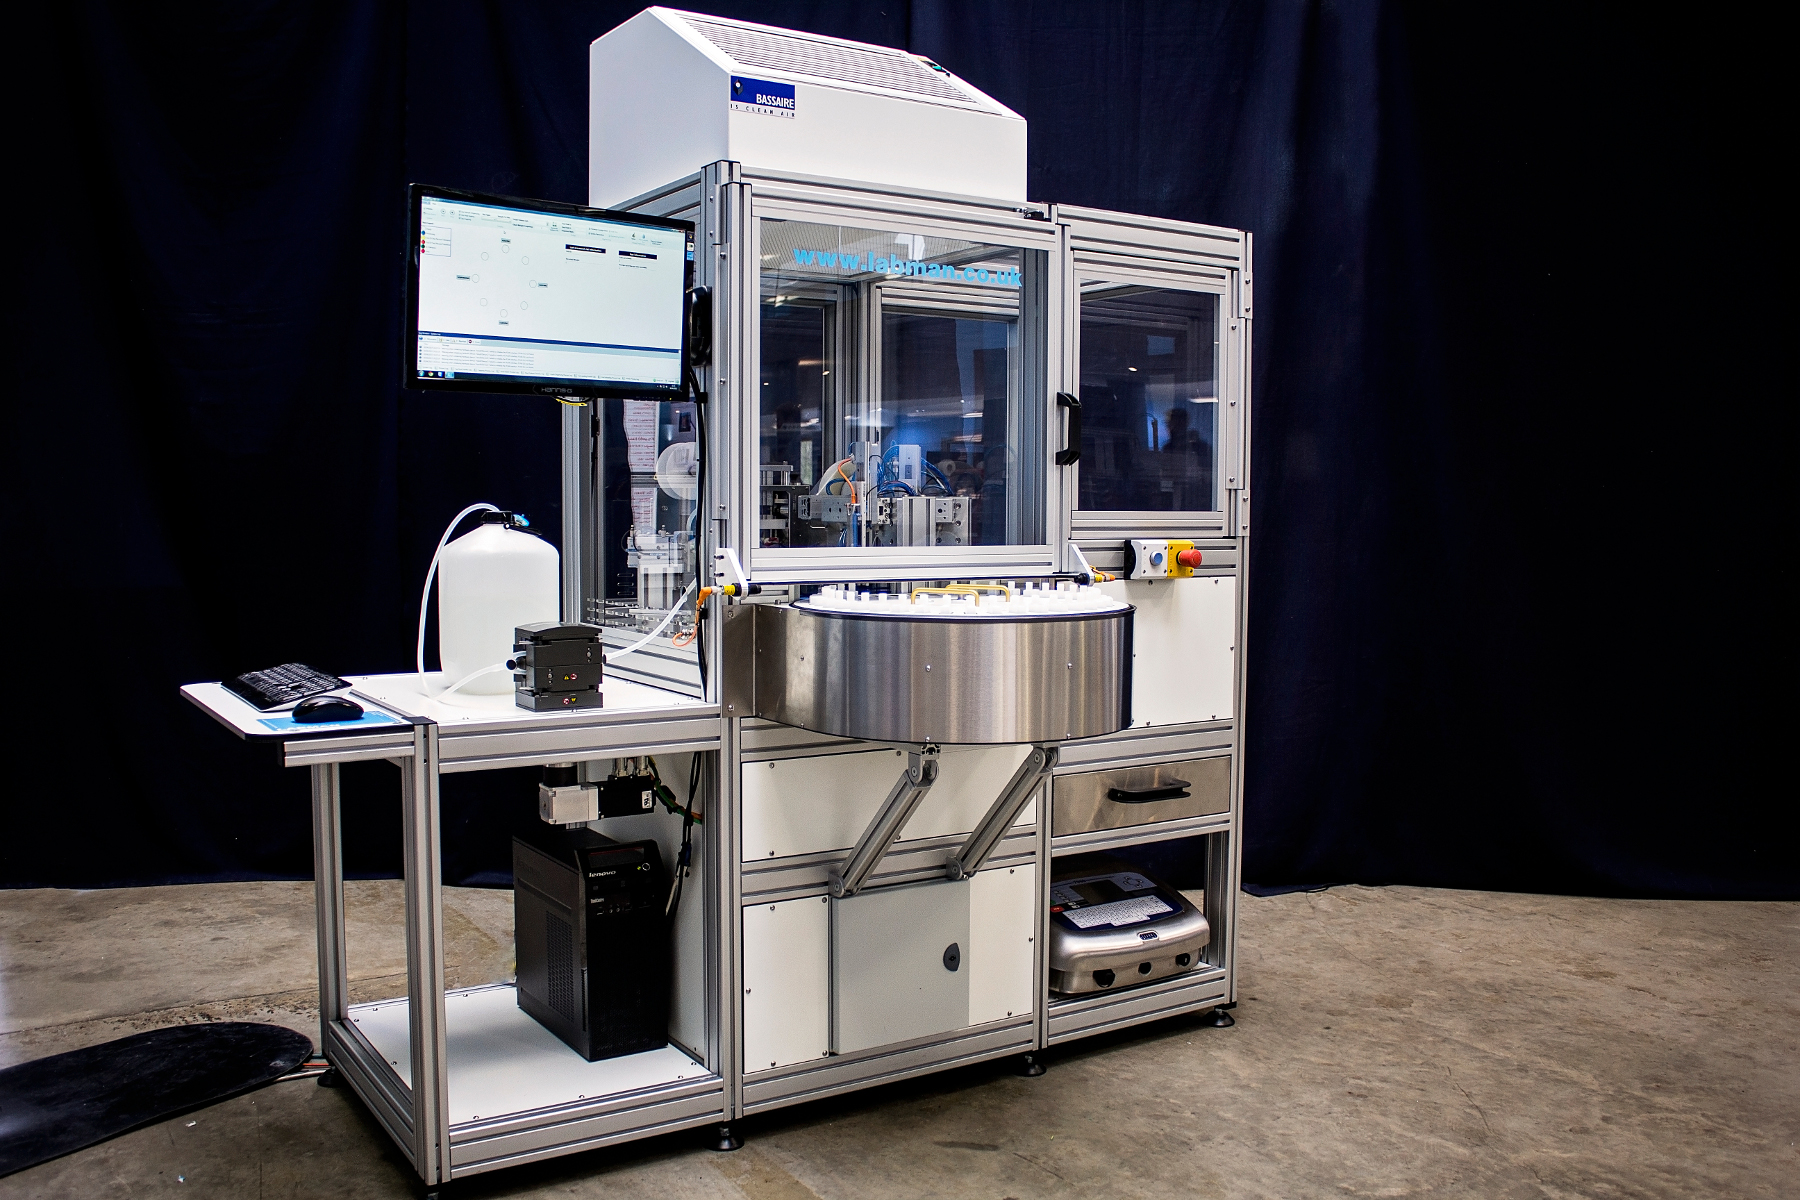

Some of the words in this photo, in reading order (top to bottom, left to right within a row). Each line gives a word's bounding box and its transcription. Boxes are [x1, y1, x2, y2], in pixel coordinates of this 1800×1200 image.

[756, 93, 795, 108] BASSAIRE
[745, 105, 774, 114] CLEAN
[793, 248, 1022, 287] www.labman.co.uk
[589, 870, 616, 878] lenovo
